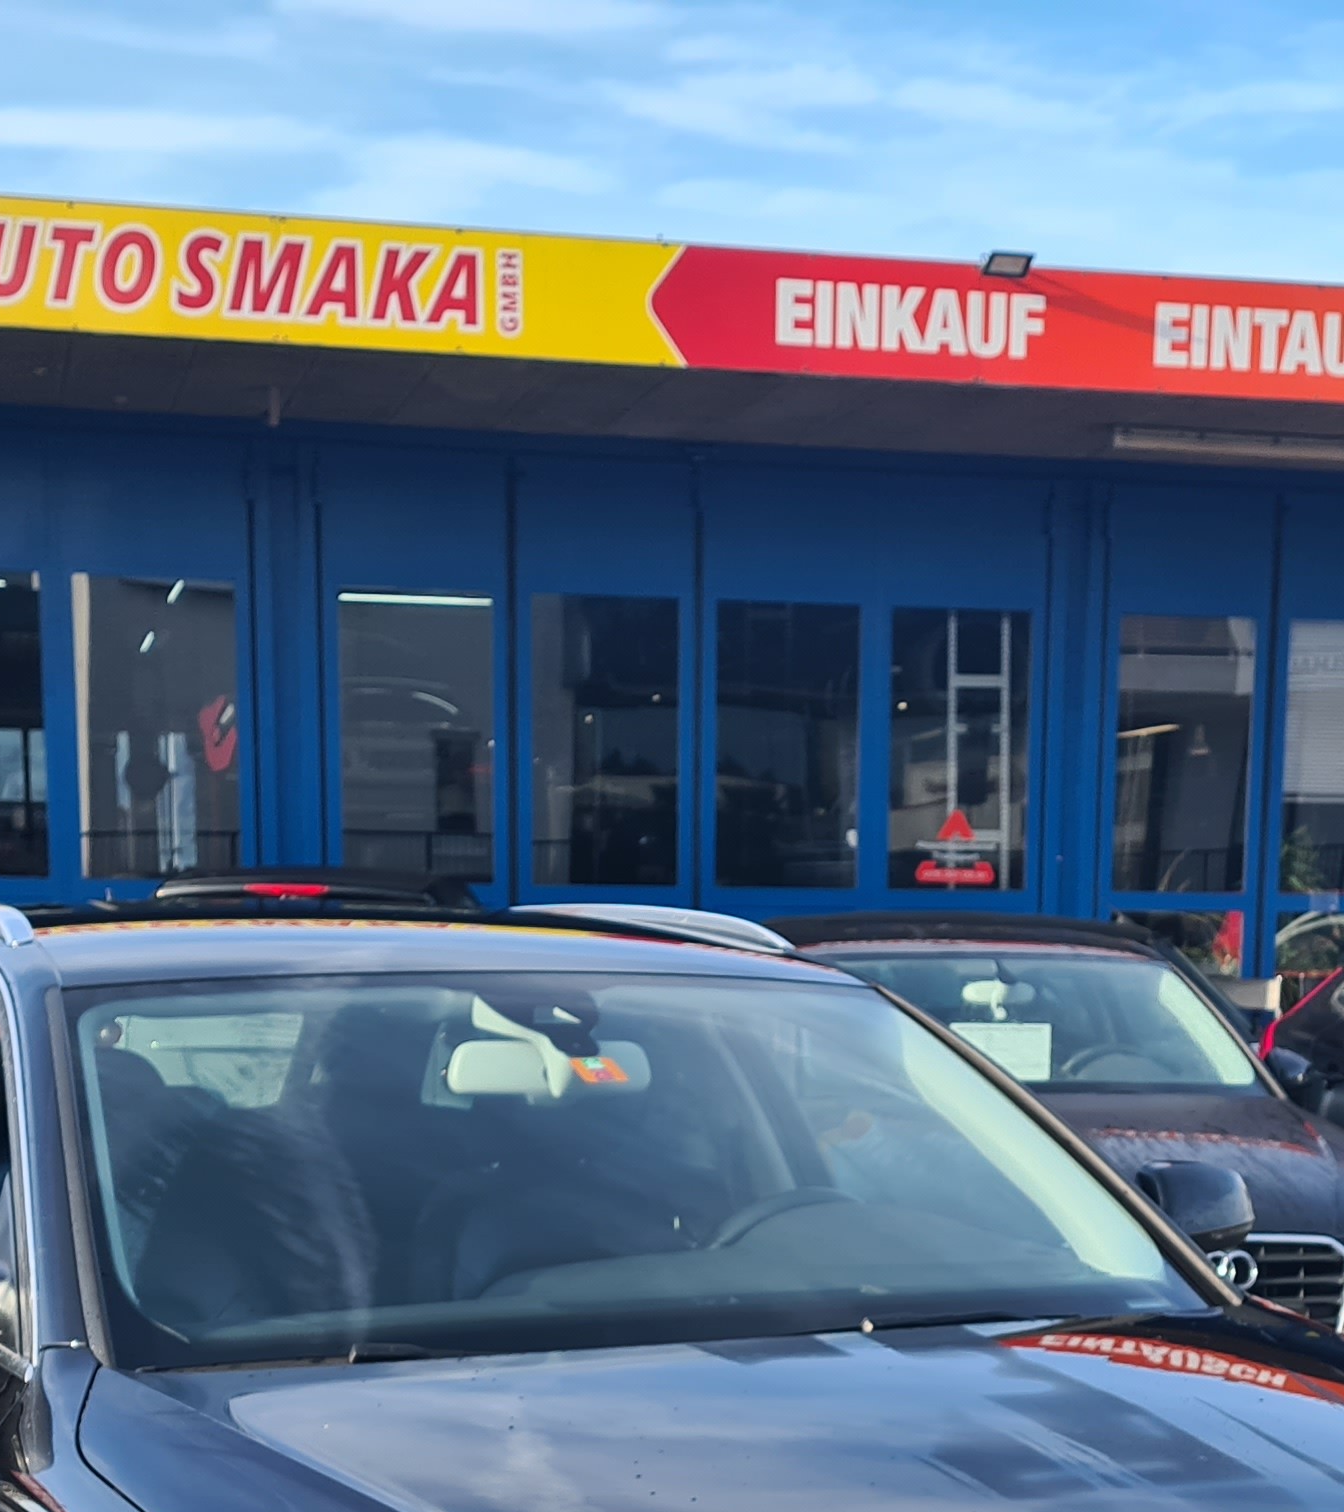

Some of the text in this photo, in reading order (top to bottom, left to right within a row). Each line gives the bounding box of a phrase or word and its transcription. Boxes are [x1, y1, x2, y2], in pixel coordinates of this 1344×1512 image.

[173, 233, 482, 331] SMAKA
[498, 250, 521, 333] GMBH
[774, 278, 1046, 360] EINKAUF
